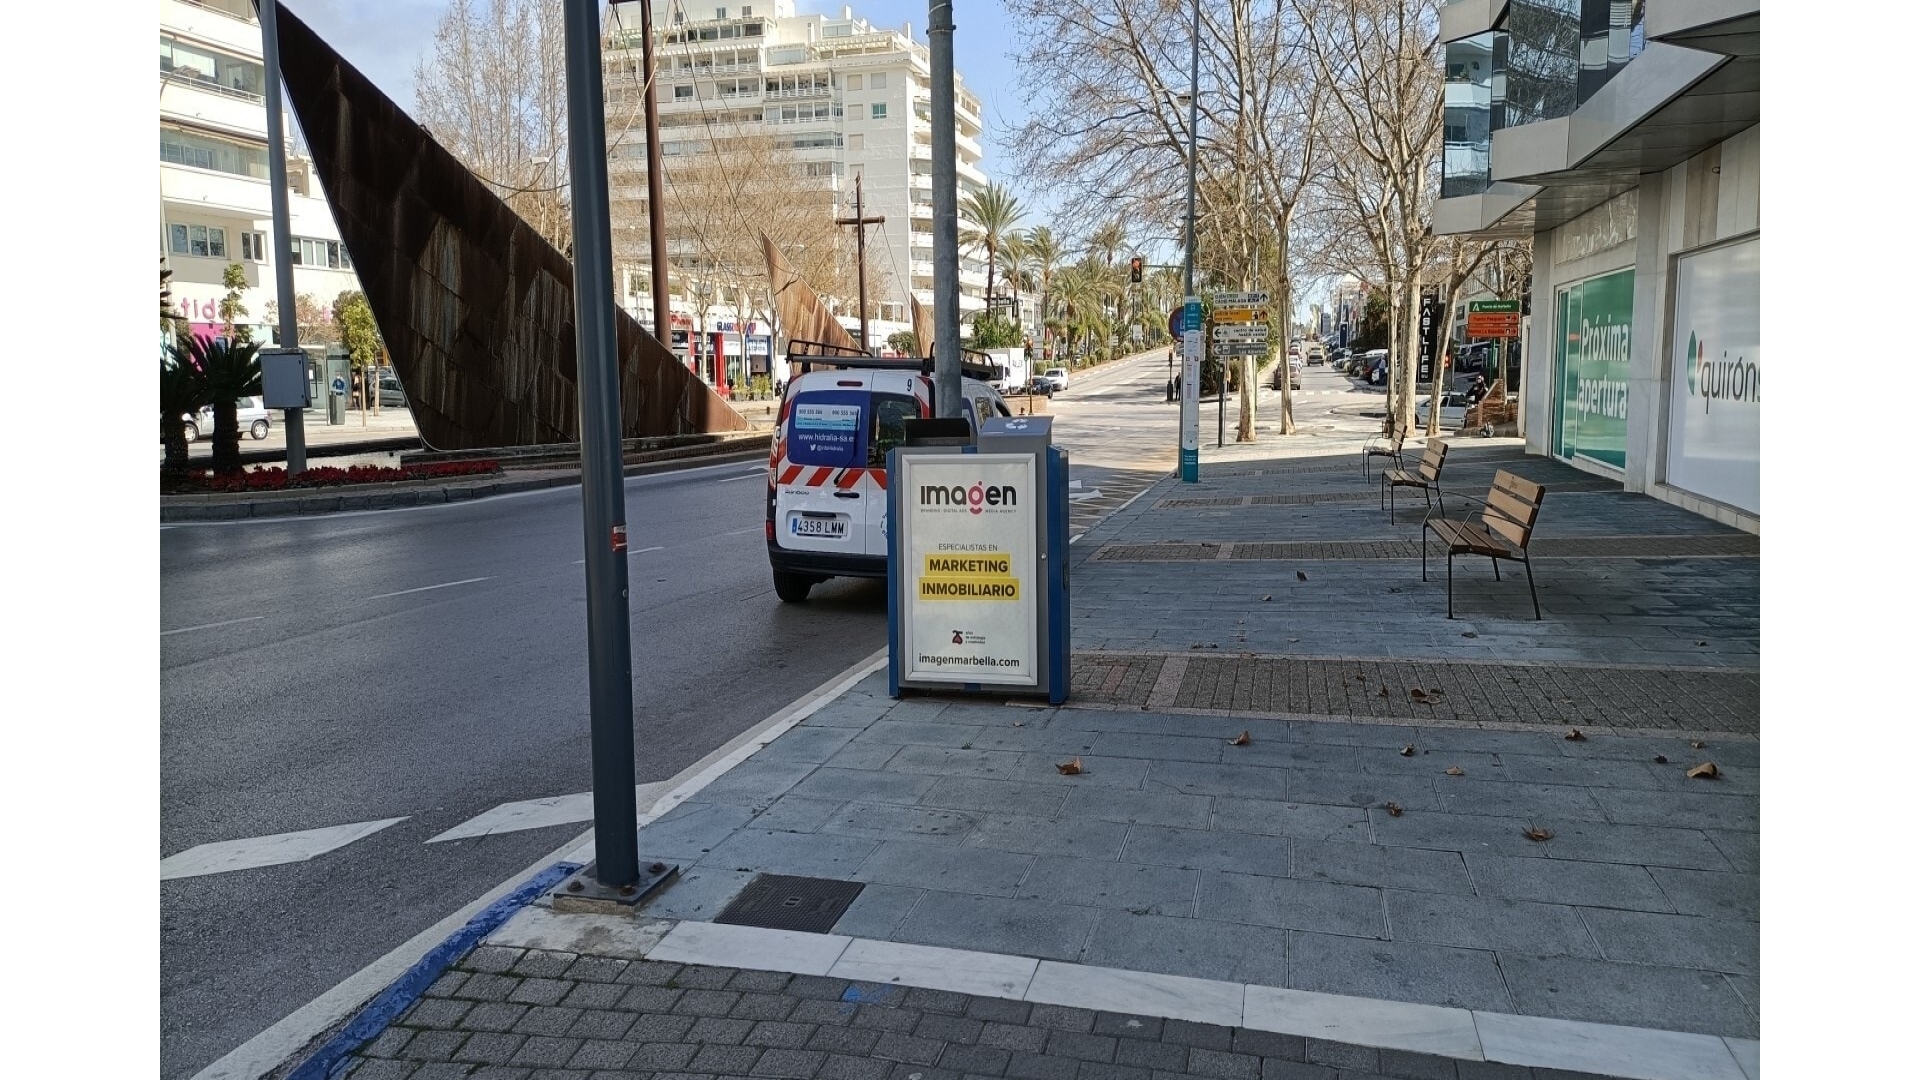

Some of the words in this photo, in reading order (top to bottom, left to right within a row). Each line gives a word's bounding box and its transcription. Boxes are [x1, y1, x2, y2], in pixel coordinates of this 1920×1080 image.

[1582, 314, 1628, 362] Próxima
[907, 379, 912, 392] 9
[1578, 374, 1627, 422] apertura
[921, 481, 1016, 514] imagen
[798, 520, 822, 532] 4358
[825, 522, 844, 534] LMM
[930, 559, 1008, 572] MARKETING
[922, 583, 1015, 597] INMOBILIARIO
[919, 653, 1019, 667] imagenmarbella.com
